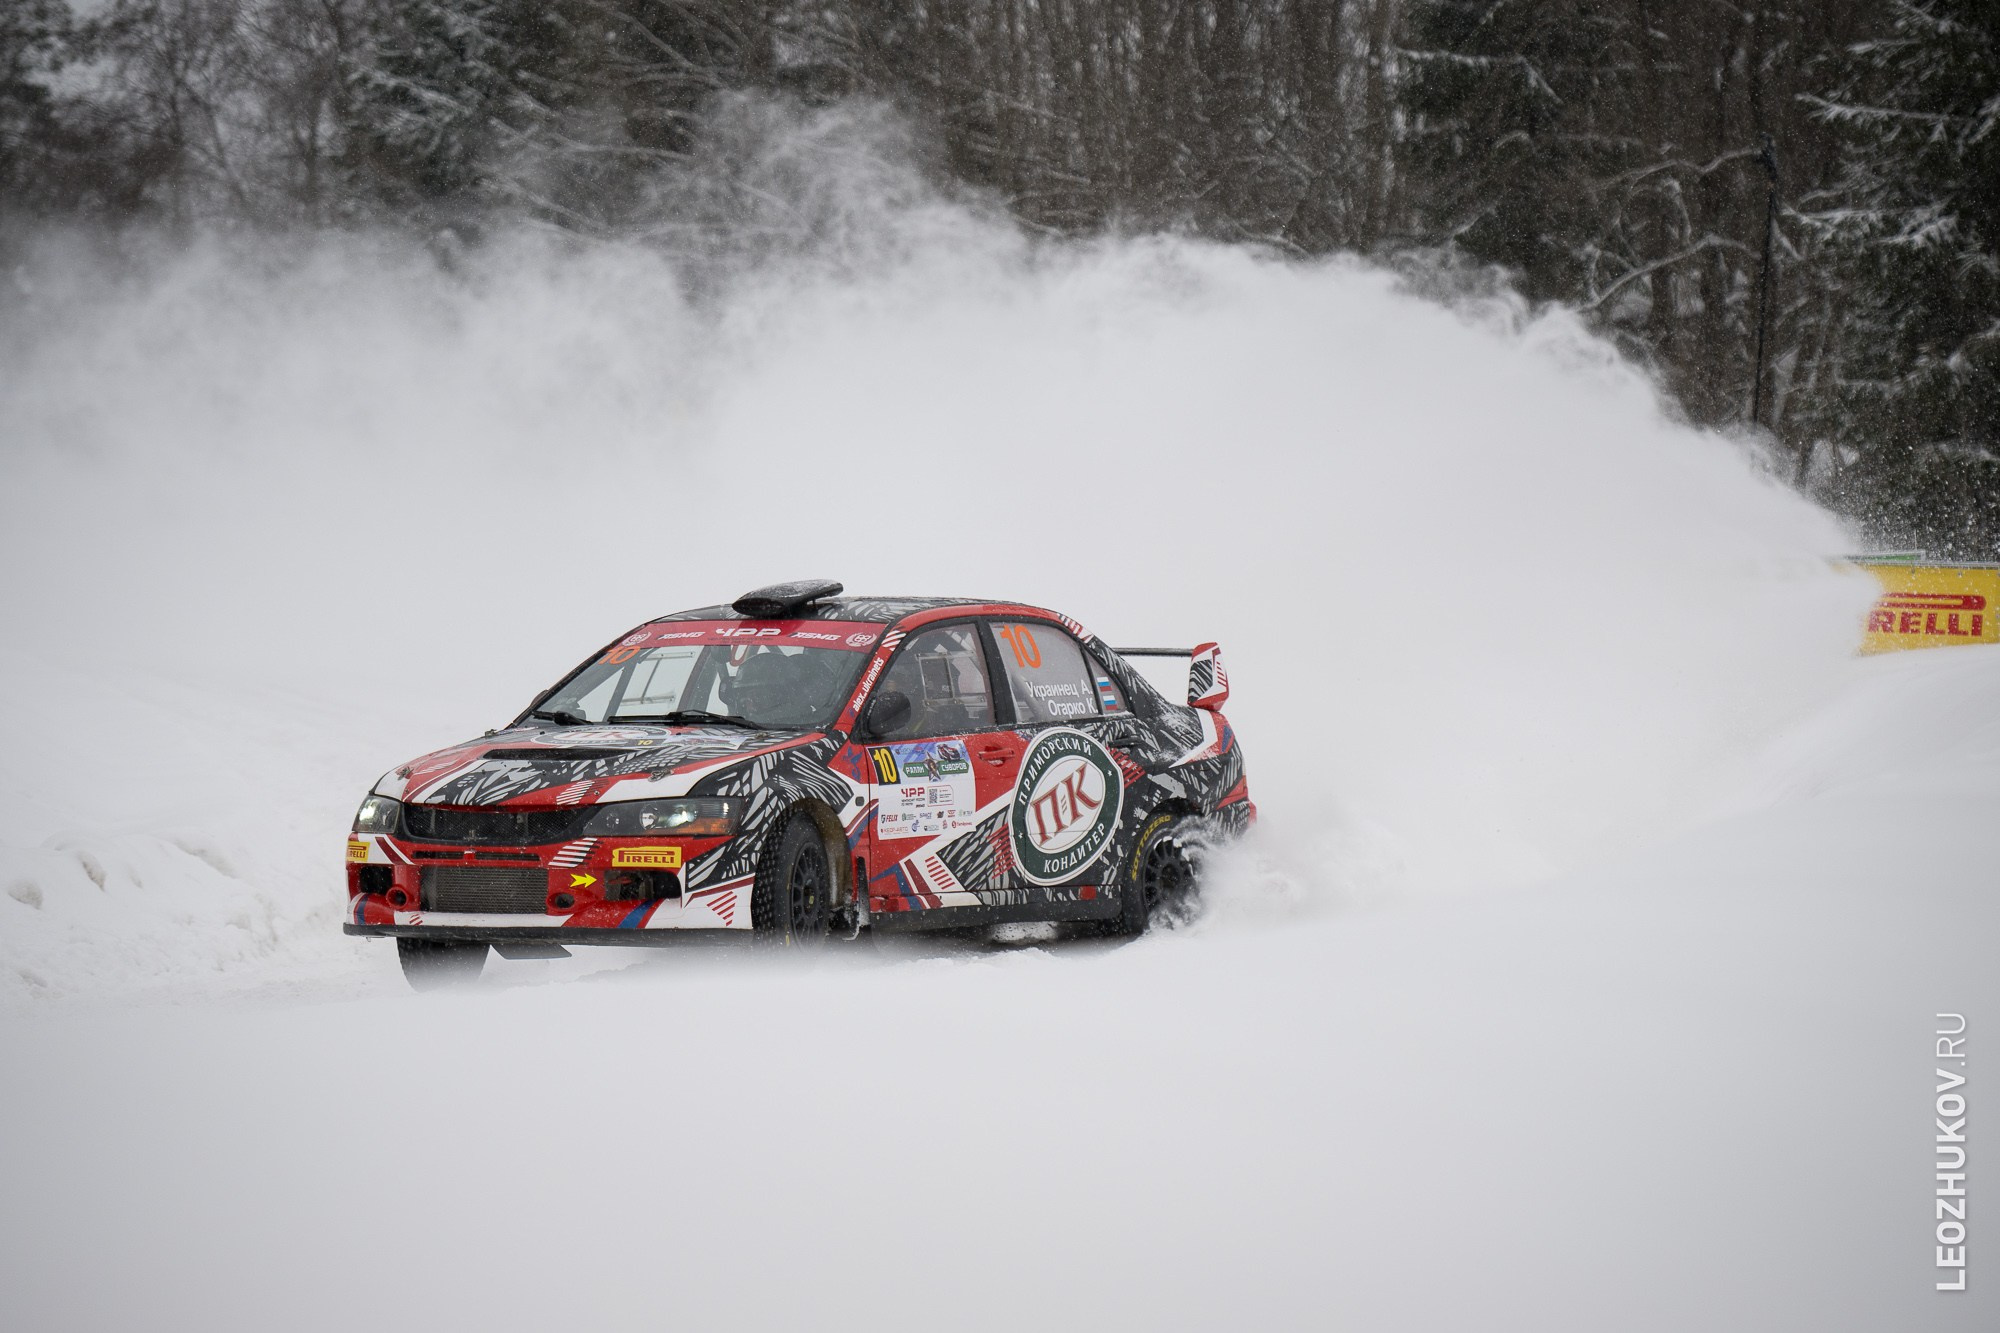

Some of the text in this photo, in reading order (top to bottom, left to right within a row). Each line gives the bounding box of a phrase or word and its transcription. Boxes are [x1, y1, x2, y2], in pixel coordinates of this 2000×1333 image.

[1860, 592, 1987, 637] RELLI
[598, 645, 641, 666] 10
[1000, 624, 1042, 669] 10
[852, 656, 885, 712] alex_ukrainets
[1026, 679, 1094, 701] Украинец А.
[1047, 697, 1099, 718] Огарко К.
[873, 748, 897, 782] 10
[905, 762, 967, 774] РАЛЛИ СУВОРОВ
[1018, 736, 1093, 806] ПРИМОРСКИЙ
[1030, 761, 1101, 848] ПК
[617, 849, 676, 864] PIRELLI
[1043, 822, 1106, 873] КОНДИТЕР
